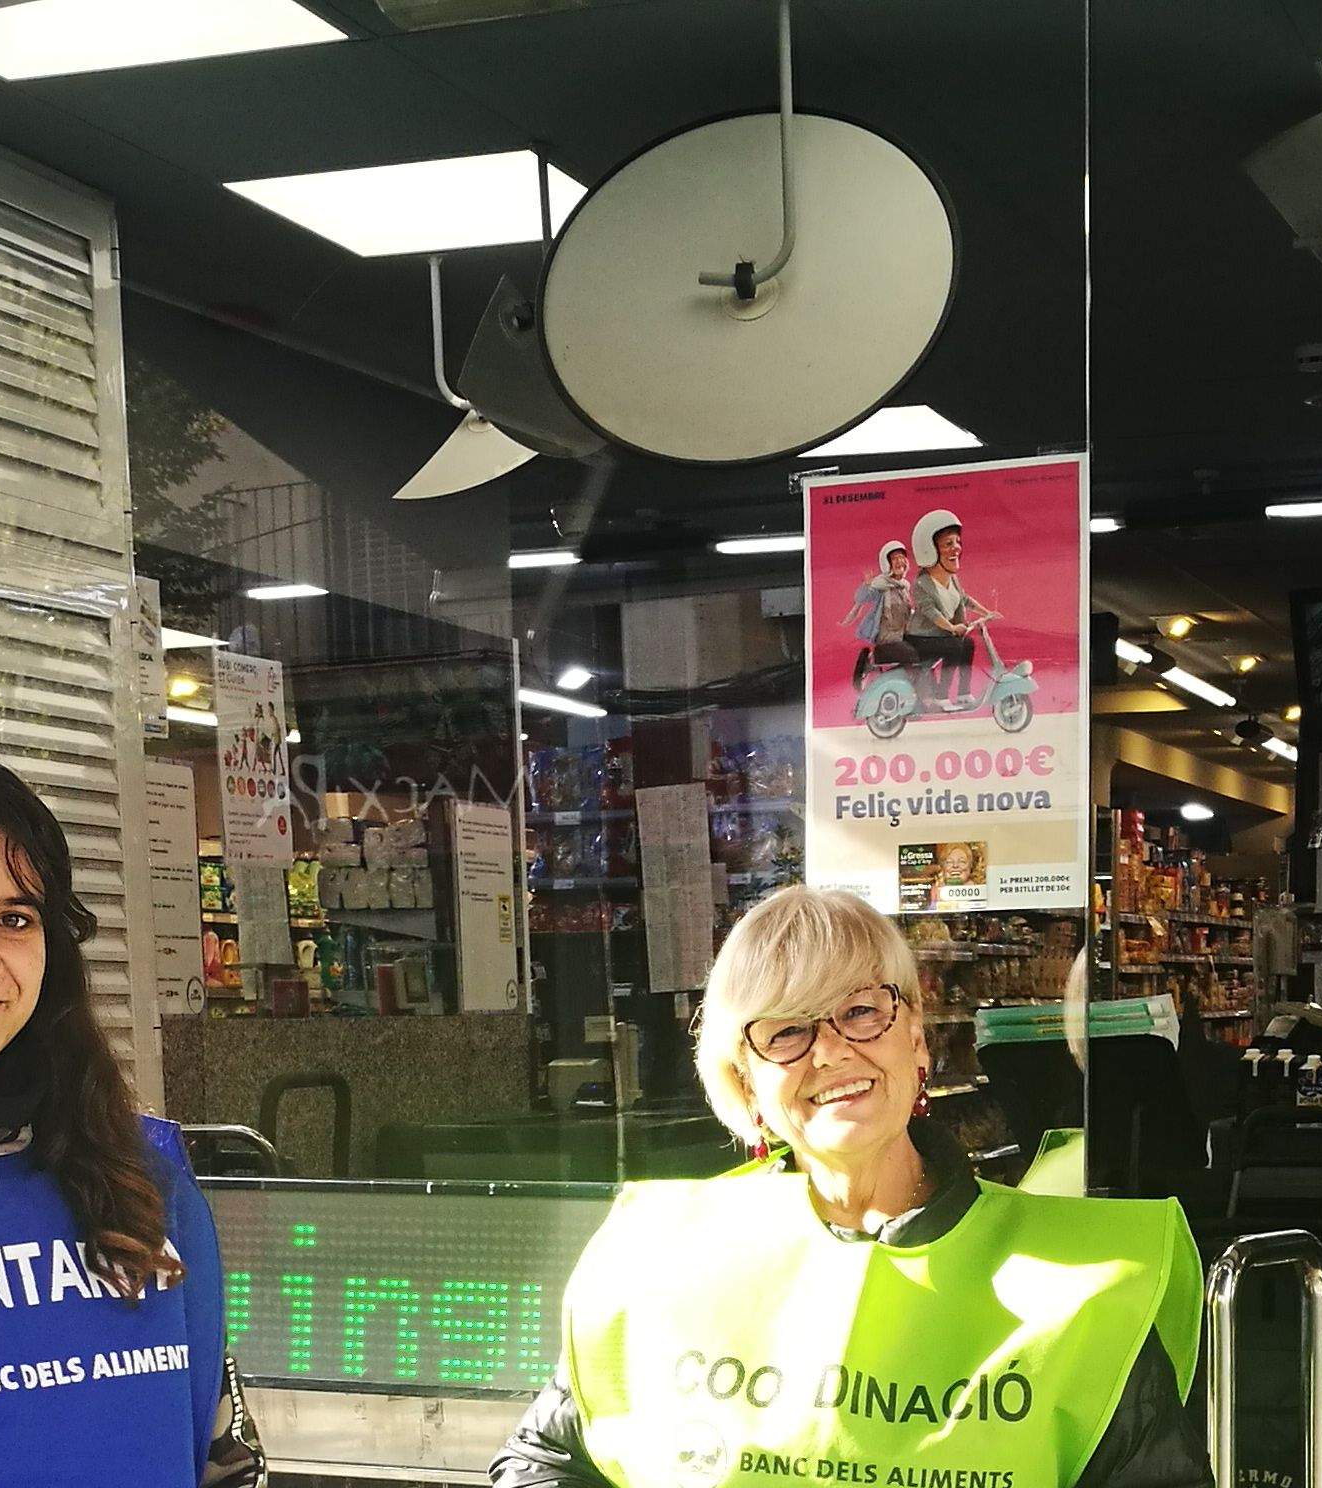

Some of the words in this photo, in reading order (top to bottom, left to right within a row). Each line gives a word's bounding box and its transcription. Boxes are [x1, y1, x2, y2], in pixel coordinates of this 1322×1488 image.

[835, 745, 1055, 786] 200.000€
[836, 791, 901, 827] Feliç
[907, 788, 969, 816] vida
[977, 789, 1051, 812] nova
[948, 888, 980, 897] 00000
[999, 886, 1013, 894] PER
[20, 1357, 85, 1389] DELS
[93, 1345, 189, 1379] ALIMENT
[675, 1350, 1033, 1424] COODINACIÓ
[740, 1452, 808, 1478] BANC
[817, 1459, 877, 1484] DELS
